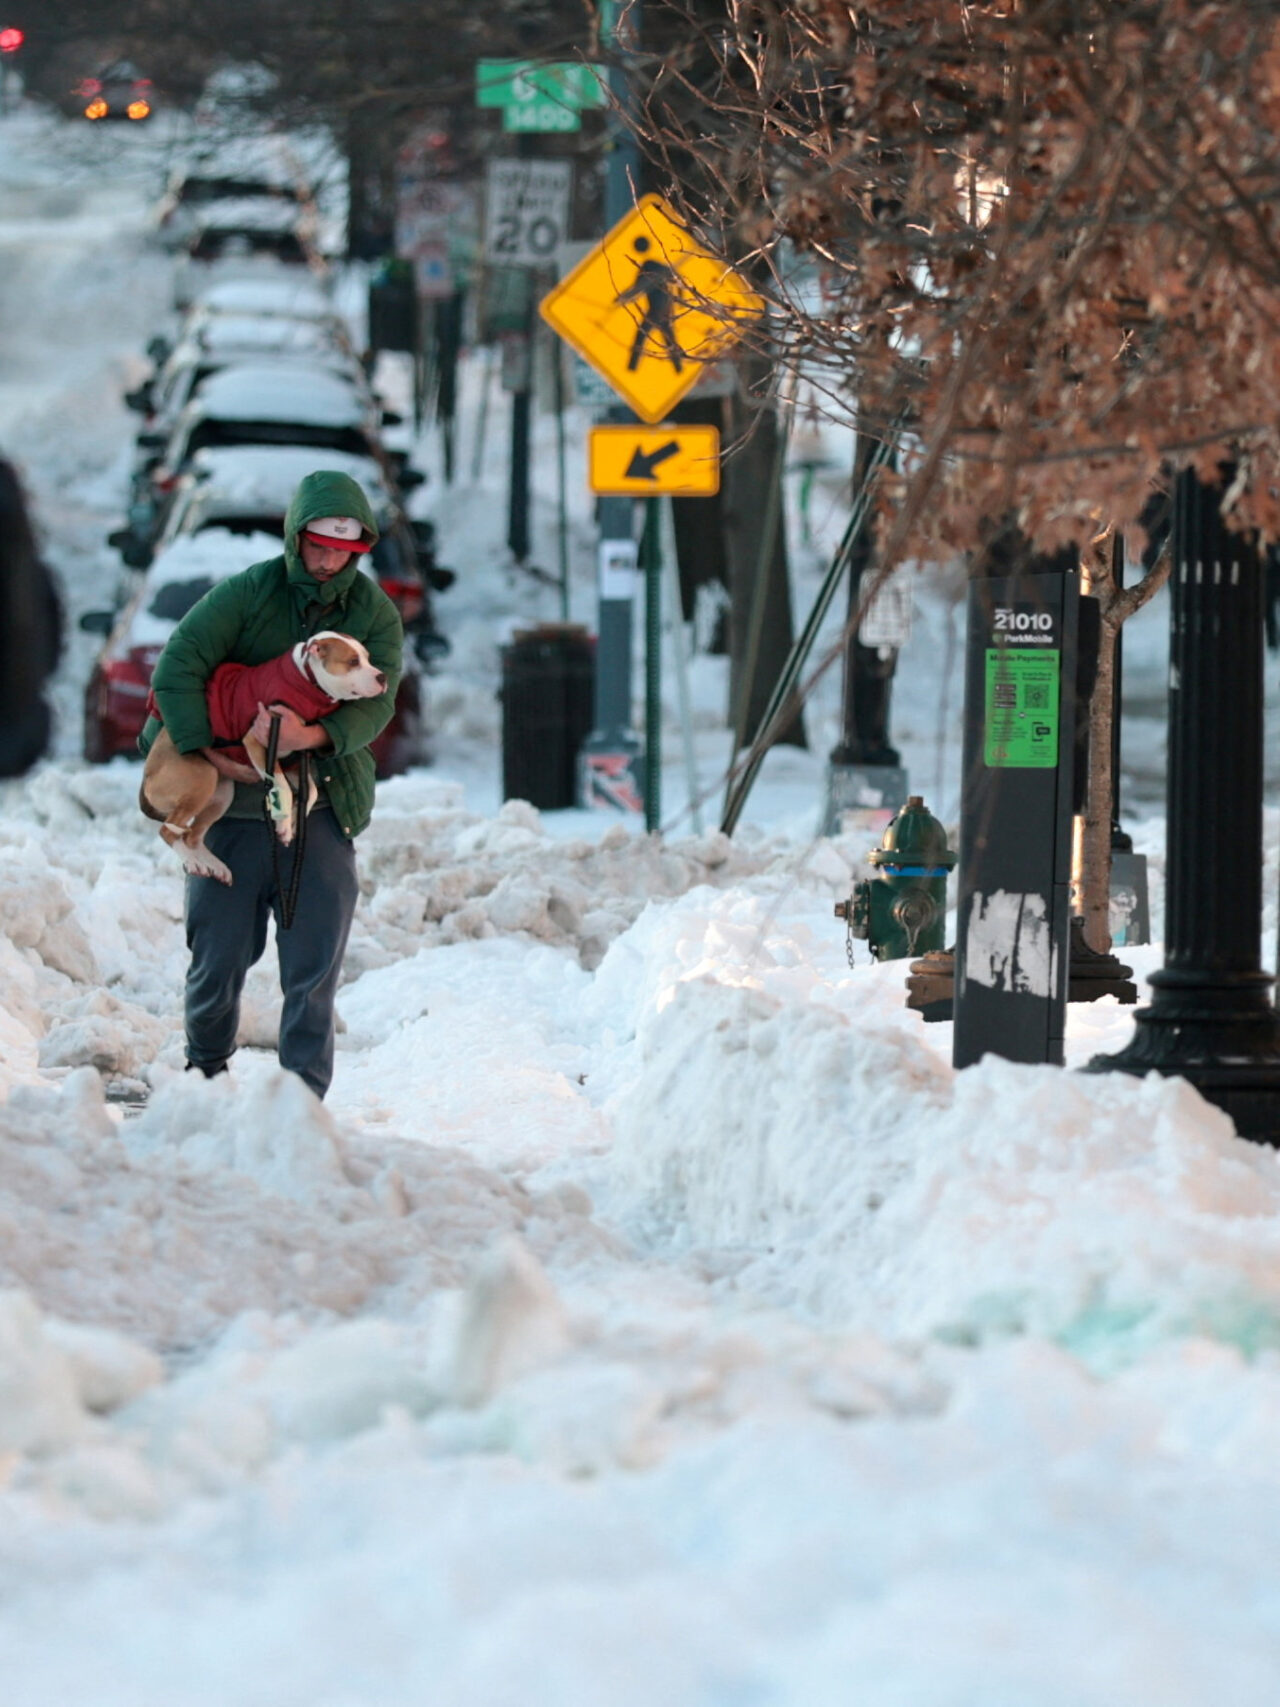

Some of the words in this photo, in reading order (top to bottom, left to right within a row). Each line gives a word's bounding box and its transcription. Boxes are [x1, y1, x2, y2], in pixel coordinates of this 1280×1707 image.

[494, 215, 561, 256] 20
[993, 612, 1053, 631] 21010
[1004, 633, 1054, 644] ParkMobile
